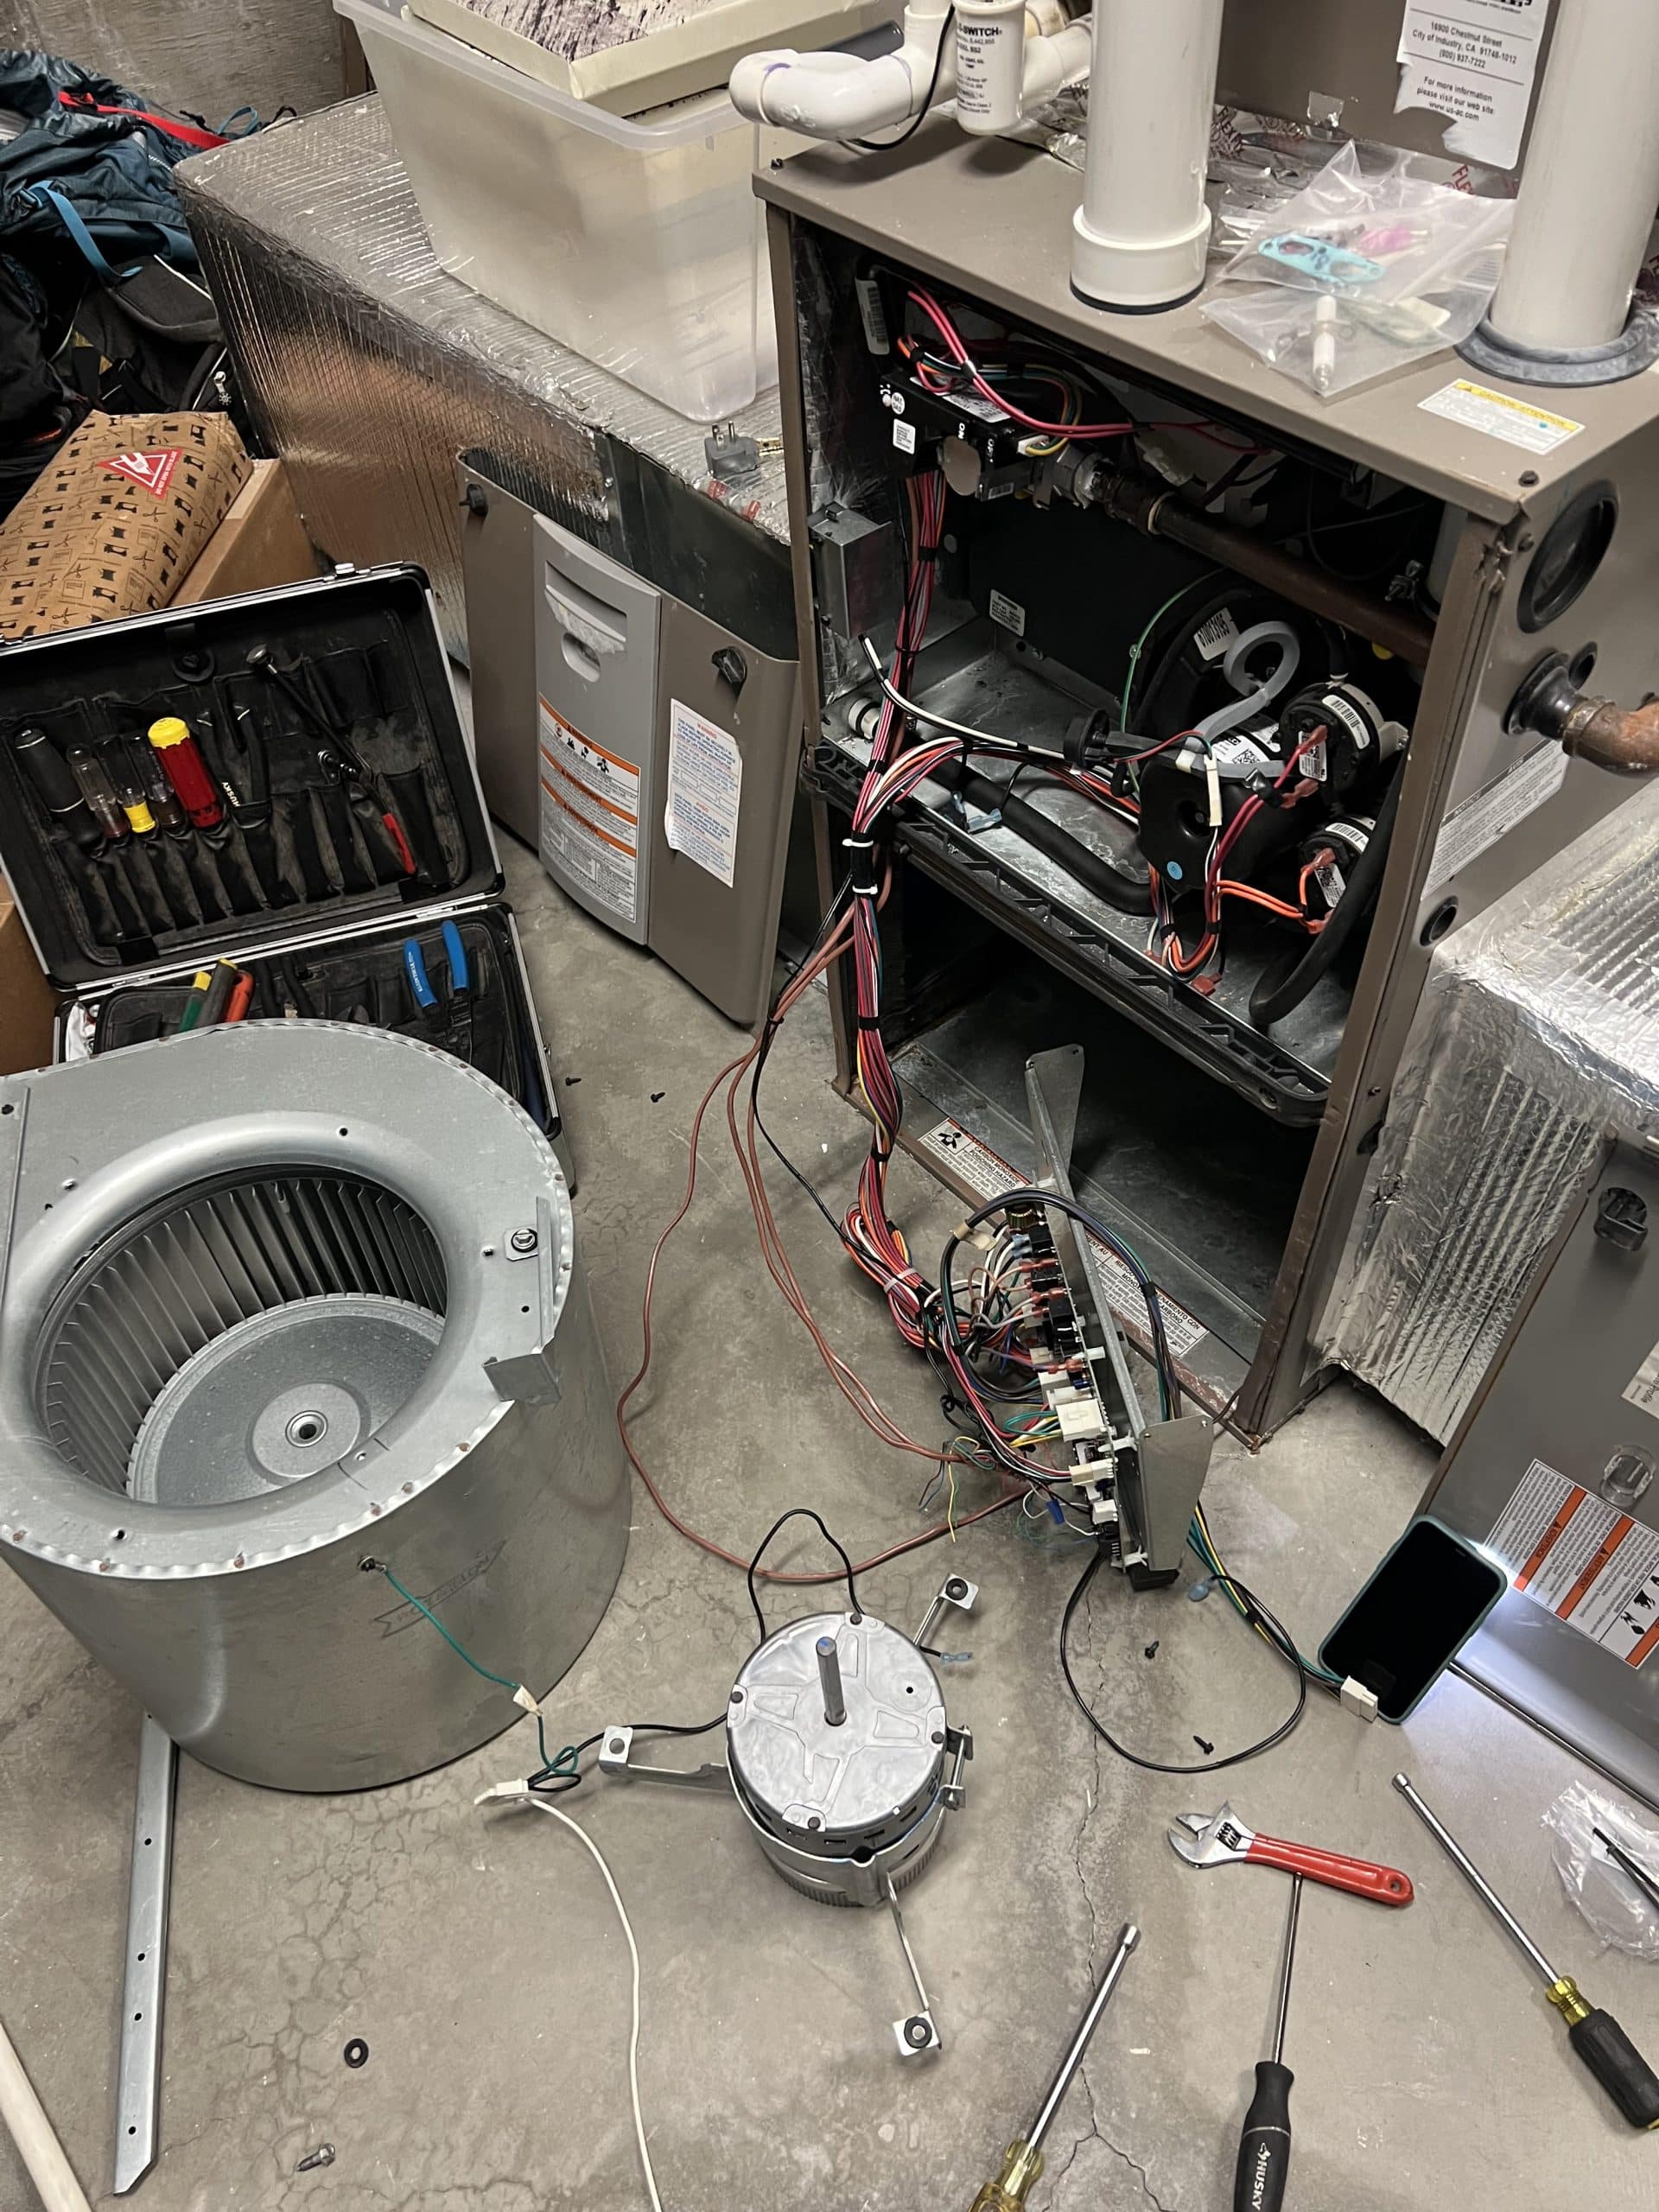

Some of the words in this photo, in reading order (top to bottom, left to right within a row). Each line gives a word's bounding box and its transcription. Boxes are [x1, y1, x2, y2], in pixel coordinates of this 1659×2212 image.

[1412, 29, 1426, 41] City
[1465, 43, 1476, 53] CA
[1431, 22, 1449, 34] 16900
[1451, 27, 1481, 42] Chestnut
[1483, 35, 1503, 48] Street
[1416, 86, 1438, 99] please
[1439, 92, 1453, 103] visit
[1453, 97, 1465, 105] our
[1466, 101, 1480, 111] web
[1423, 76, 1436, 86] For
[1436, 80, 1453, 91] more
[1454, 85, 1493, 102] information
[221, 781, 241, 807] HUSKY
[995, 1170, 1016, 1189] HAZARD
[1251, 2160, 1268, 2211] HUSKY
